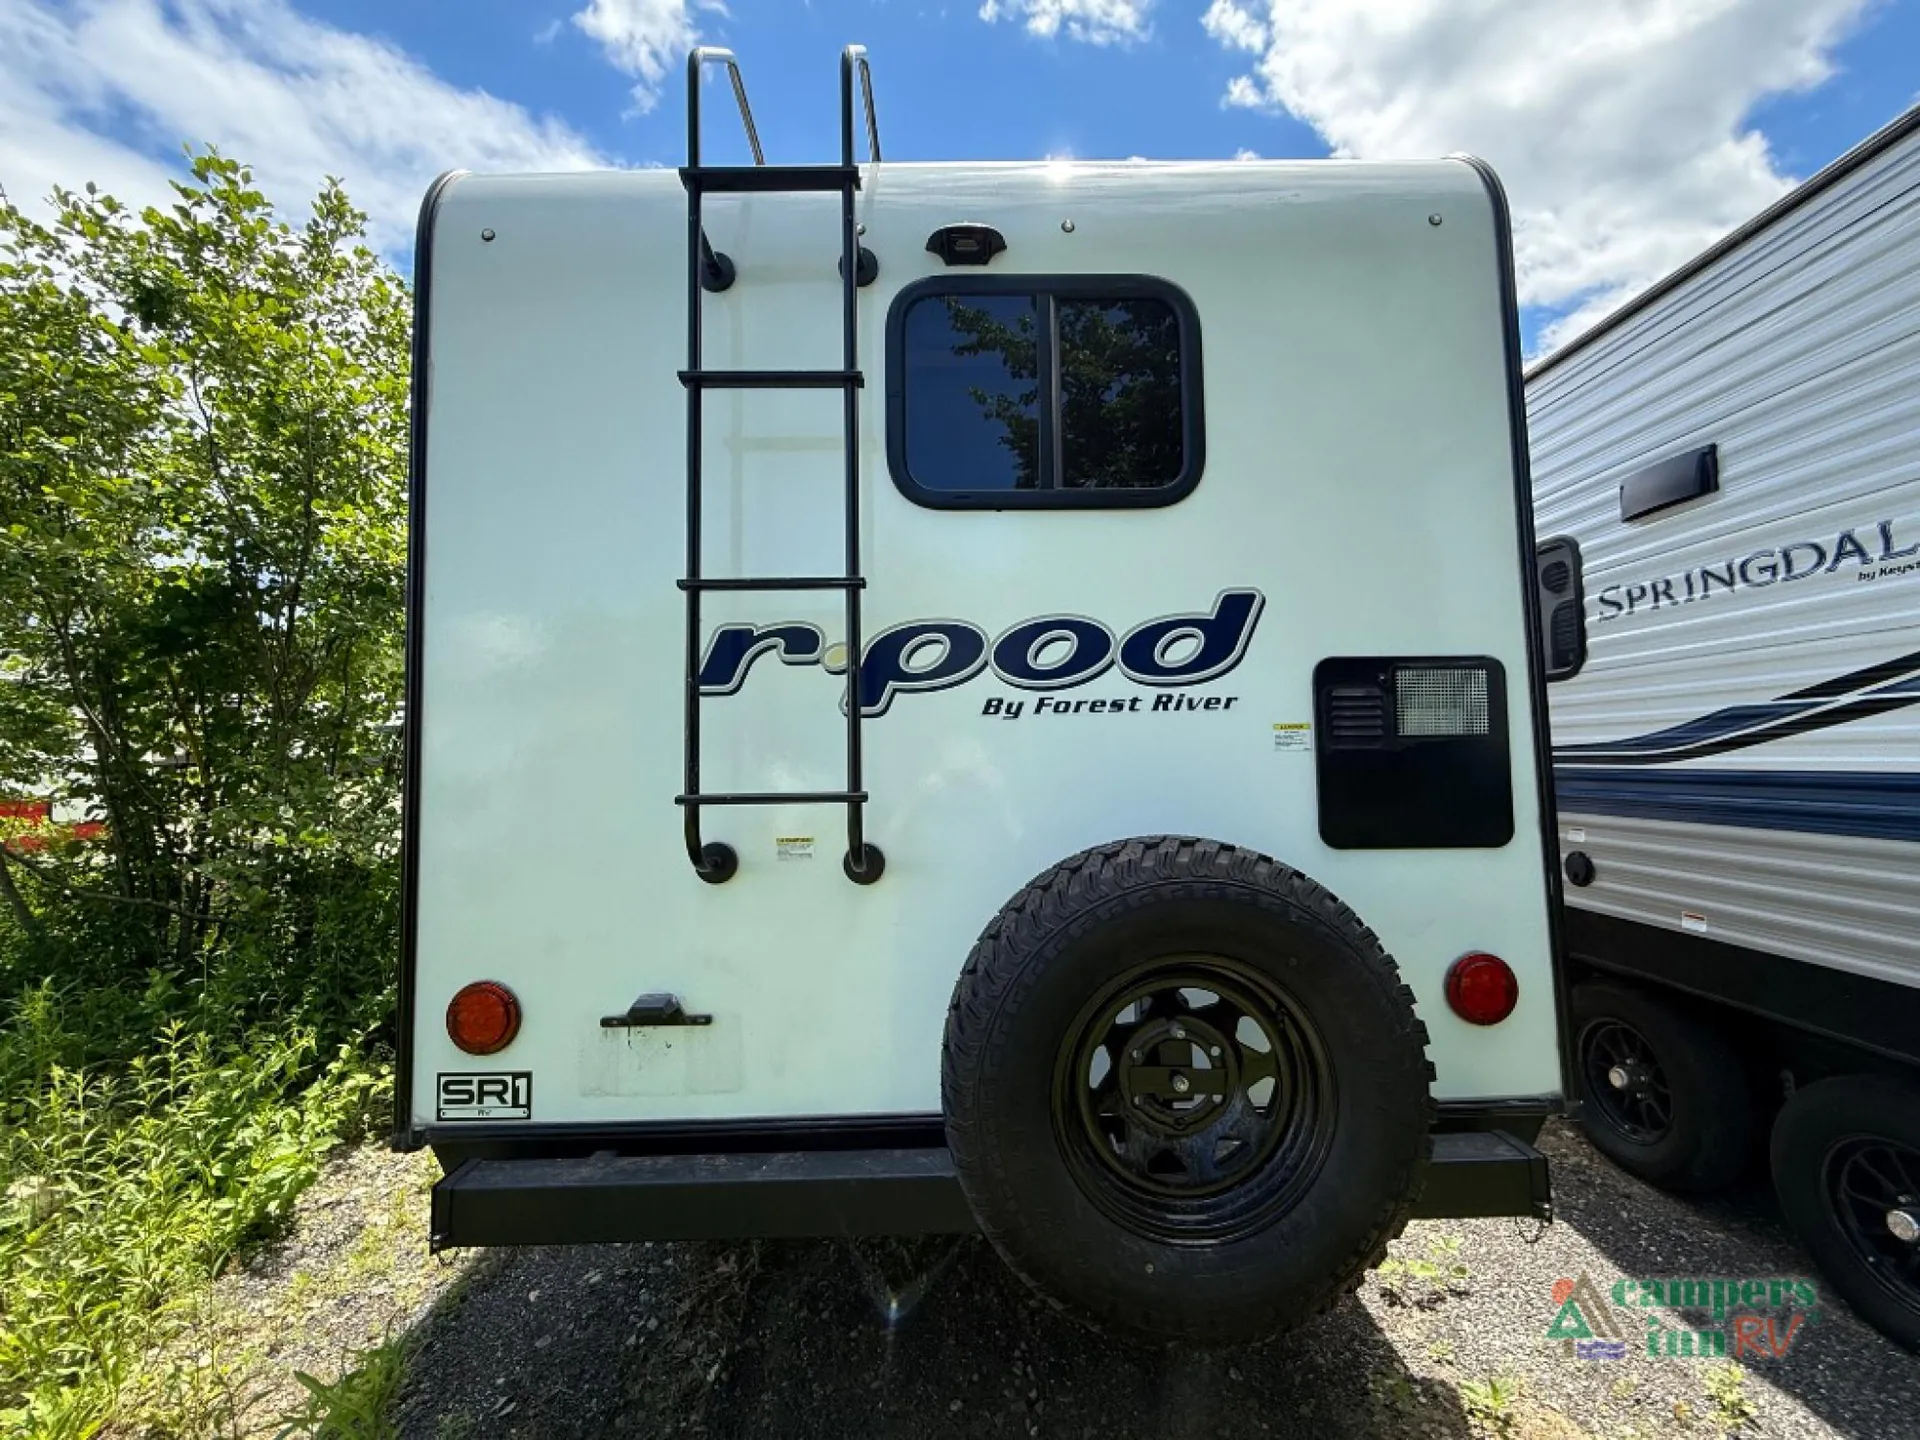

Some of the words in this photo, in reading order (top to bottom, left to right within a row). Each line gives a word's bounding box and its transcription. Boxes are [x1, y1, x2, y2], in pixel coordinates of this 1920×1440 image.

[982, 697, 1024, 720] By
[1033, 696, 1143, 715] Forest
[1151, 693, 1239, 712] River
[442, 1078, 528, 1105] SR1
